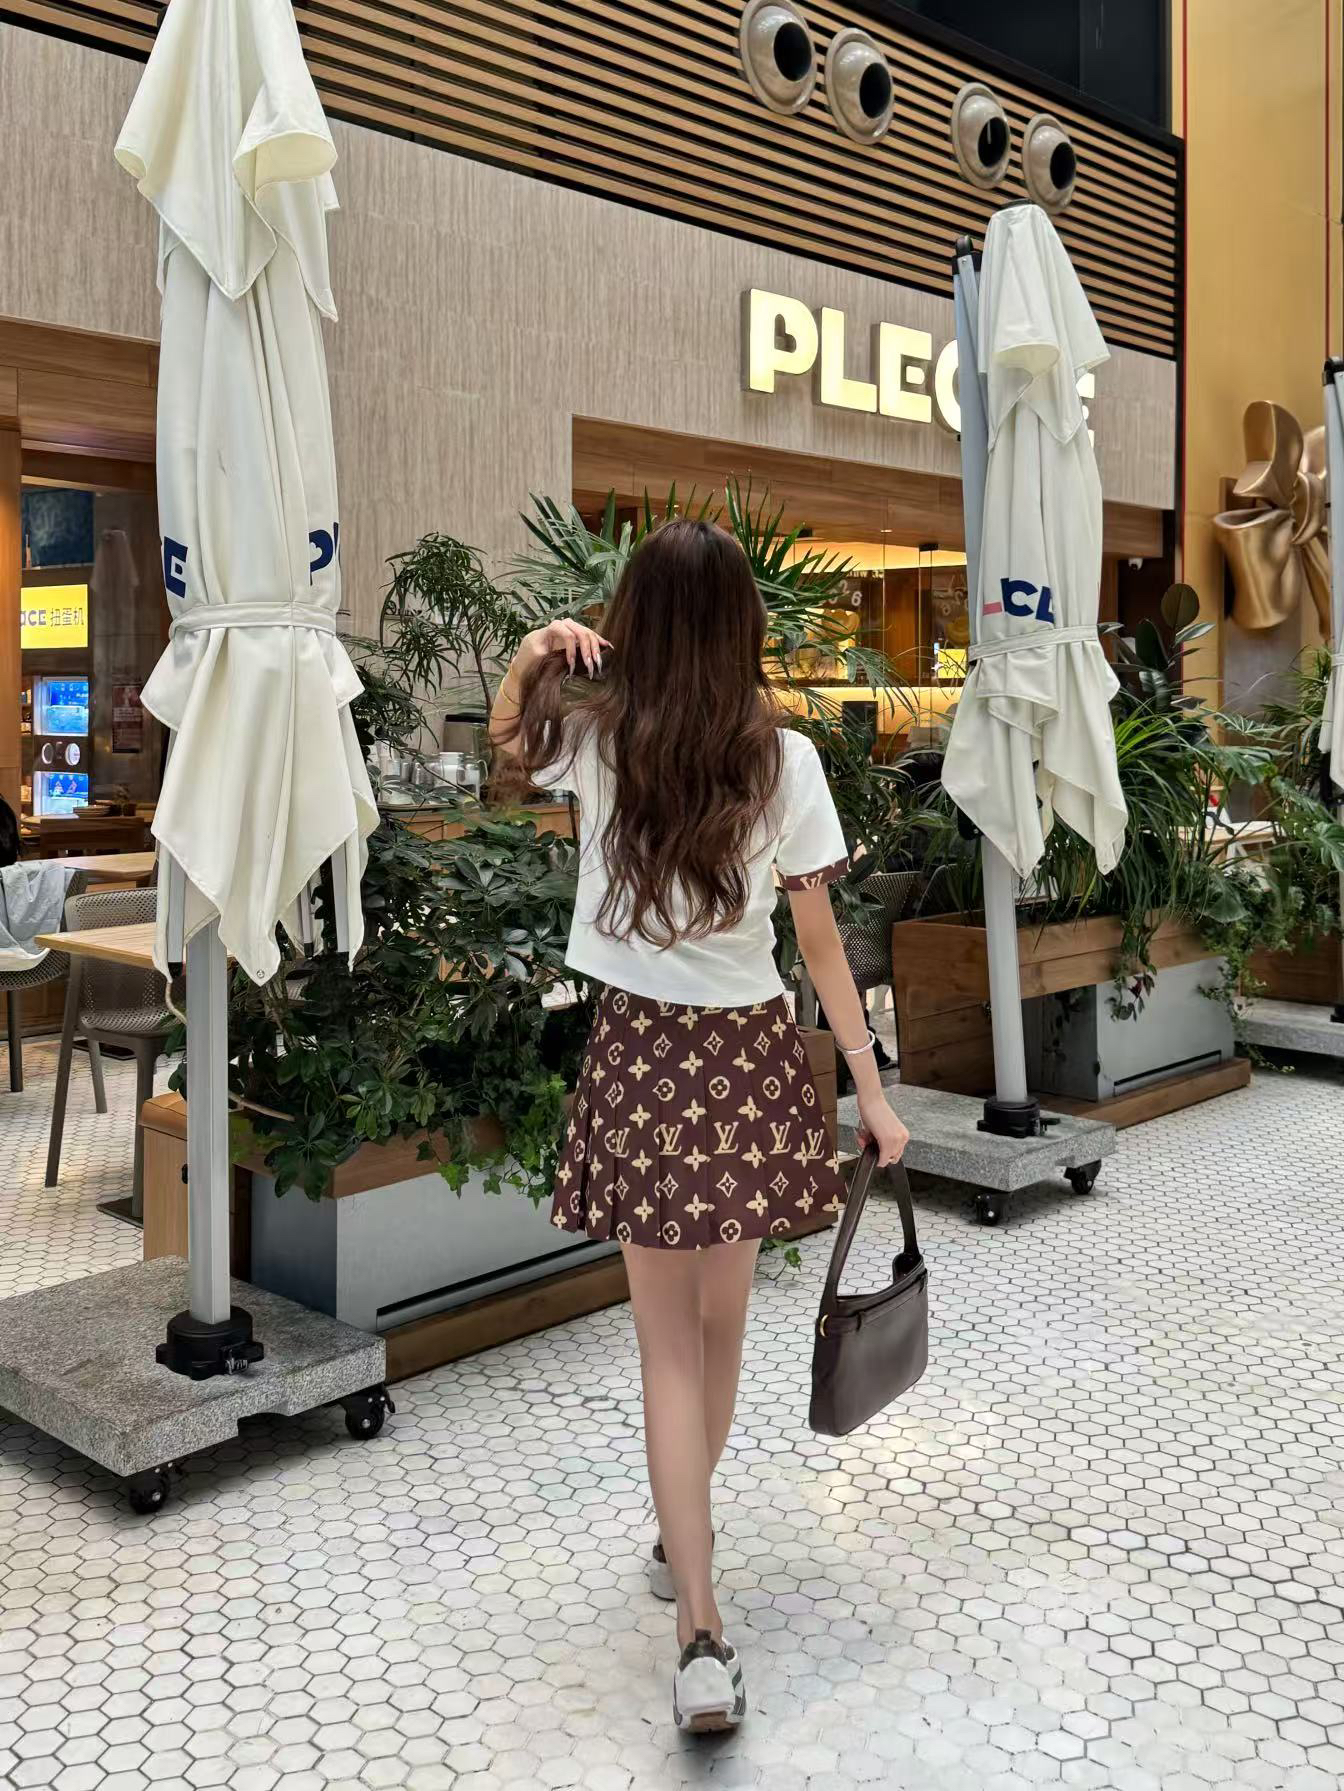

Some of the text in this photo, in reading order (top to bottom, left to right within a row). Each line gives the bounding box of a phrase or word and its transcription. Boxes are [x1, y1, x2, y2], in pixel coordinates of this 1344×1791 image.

[659, 1123, 684, 1155] LV
[713, 1121, 739, 1154] LV
[769, 1121, 791, 1154] LV
